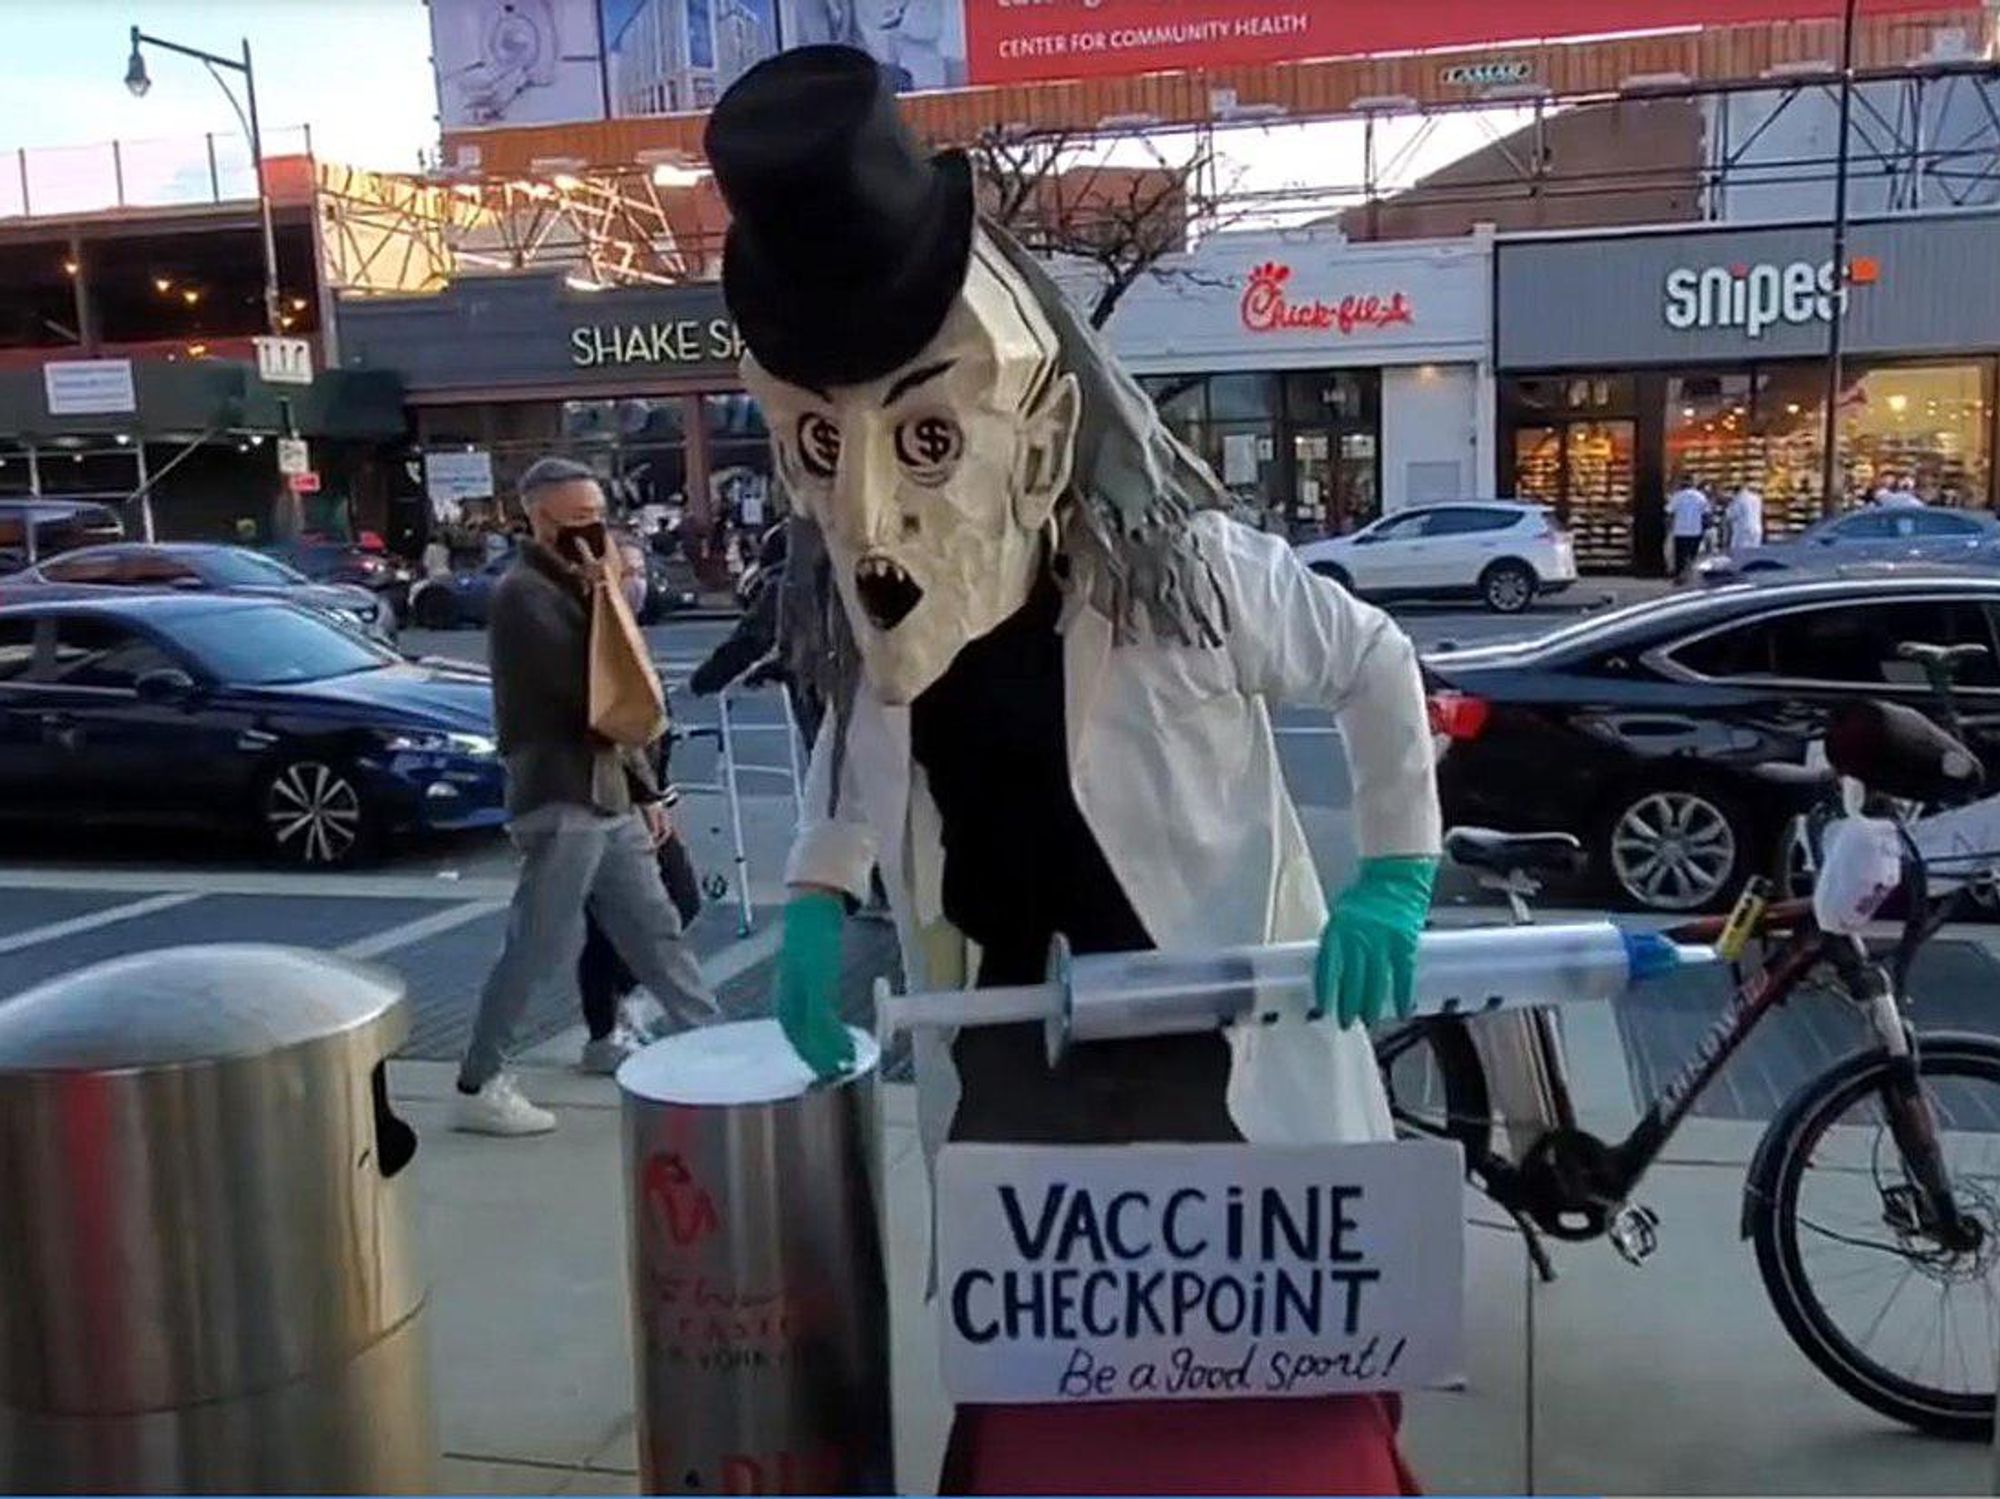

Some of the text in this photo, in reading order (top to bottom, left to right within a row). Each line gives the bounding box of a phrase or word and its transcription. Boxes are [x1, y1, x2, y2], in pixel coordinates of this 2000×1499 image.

[1000, 13, 1307, 58] CENTER FOR COMMUNITY HEALTH
[1665, 261, 1849, 337] snipes
[572, 321, 700, 365] SHAKE
[1059, 1347, 1116, 1397] Be
[1128, 1362, 1157, 1390] a
[1165, 1344, 1256, 1393] good
